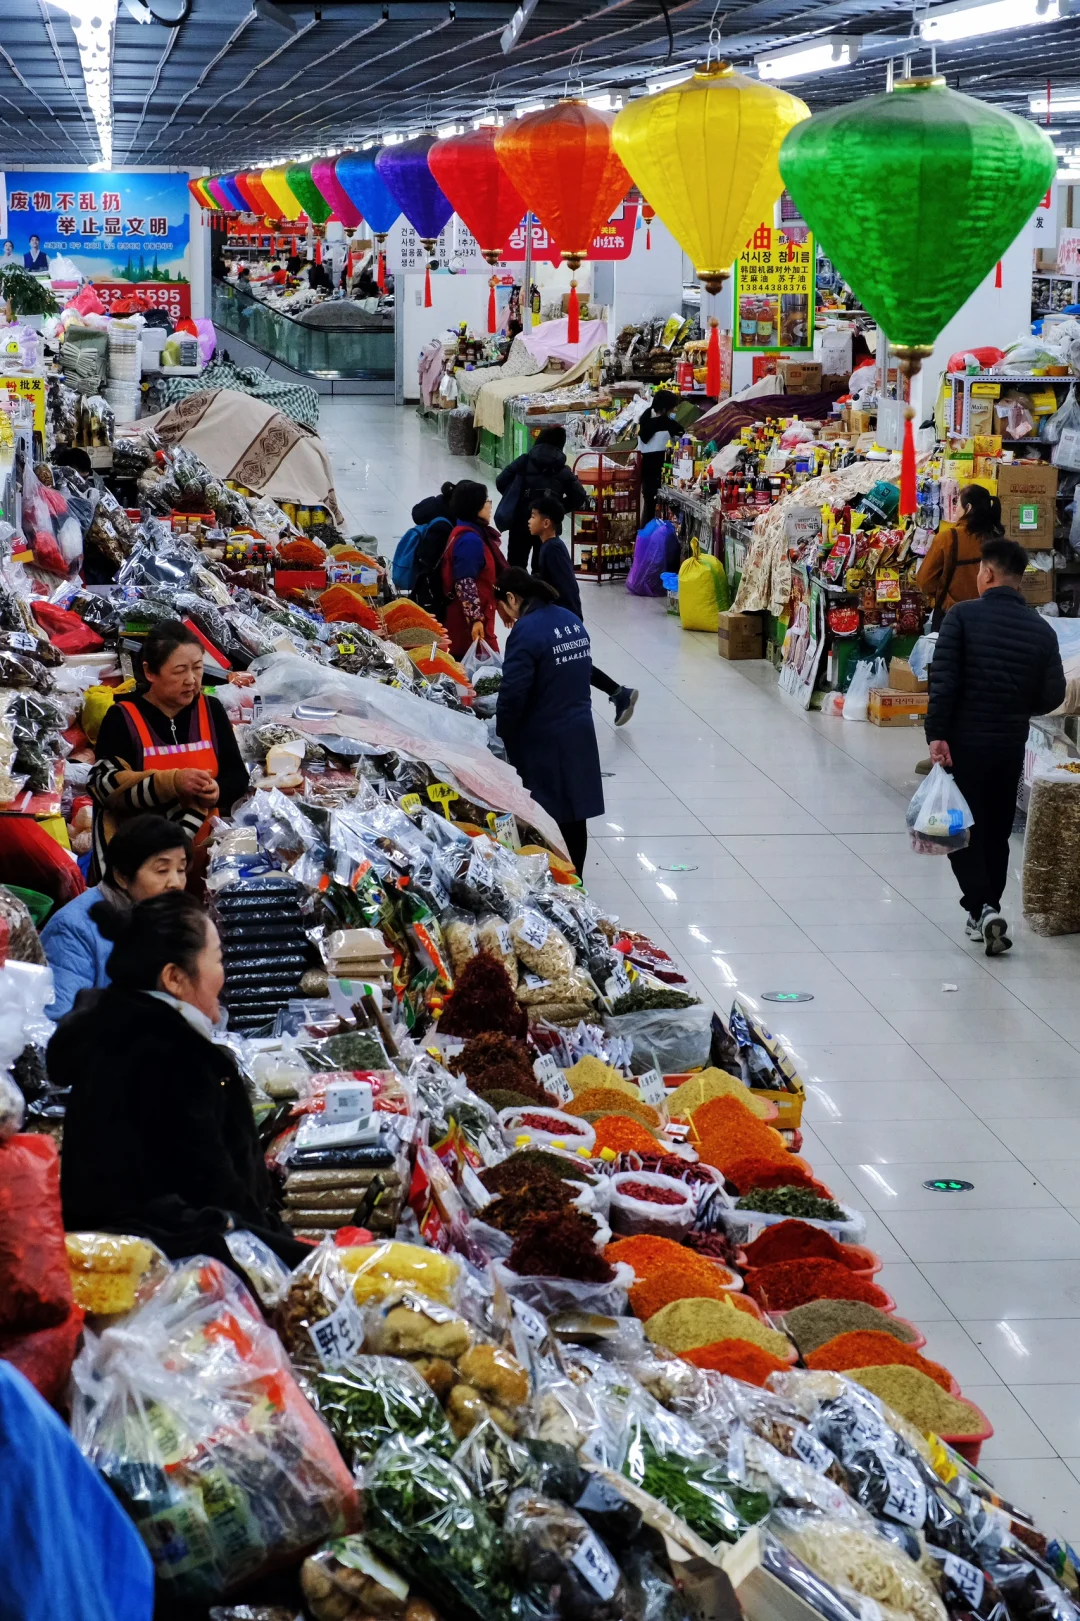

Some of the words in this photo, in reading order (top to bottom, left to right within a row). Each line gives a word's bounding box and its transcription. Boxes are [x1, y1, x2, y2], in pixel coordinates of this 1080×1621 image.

[10, 192, 120, 211] 废物不乱扔
[58, 217, 168, 236] 举止显文明
[401, 249, 423, 257] 일용품
[741, 251, 772, 263] 서시장
[741, 266, 809, 274] 韩国机器对外加工
[741, 275, 769, 283] 芝麻油
[778, 275, 806, 283] 苏子油
[20, 380, 42, 390] 批发
